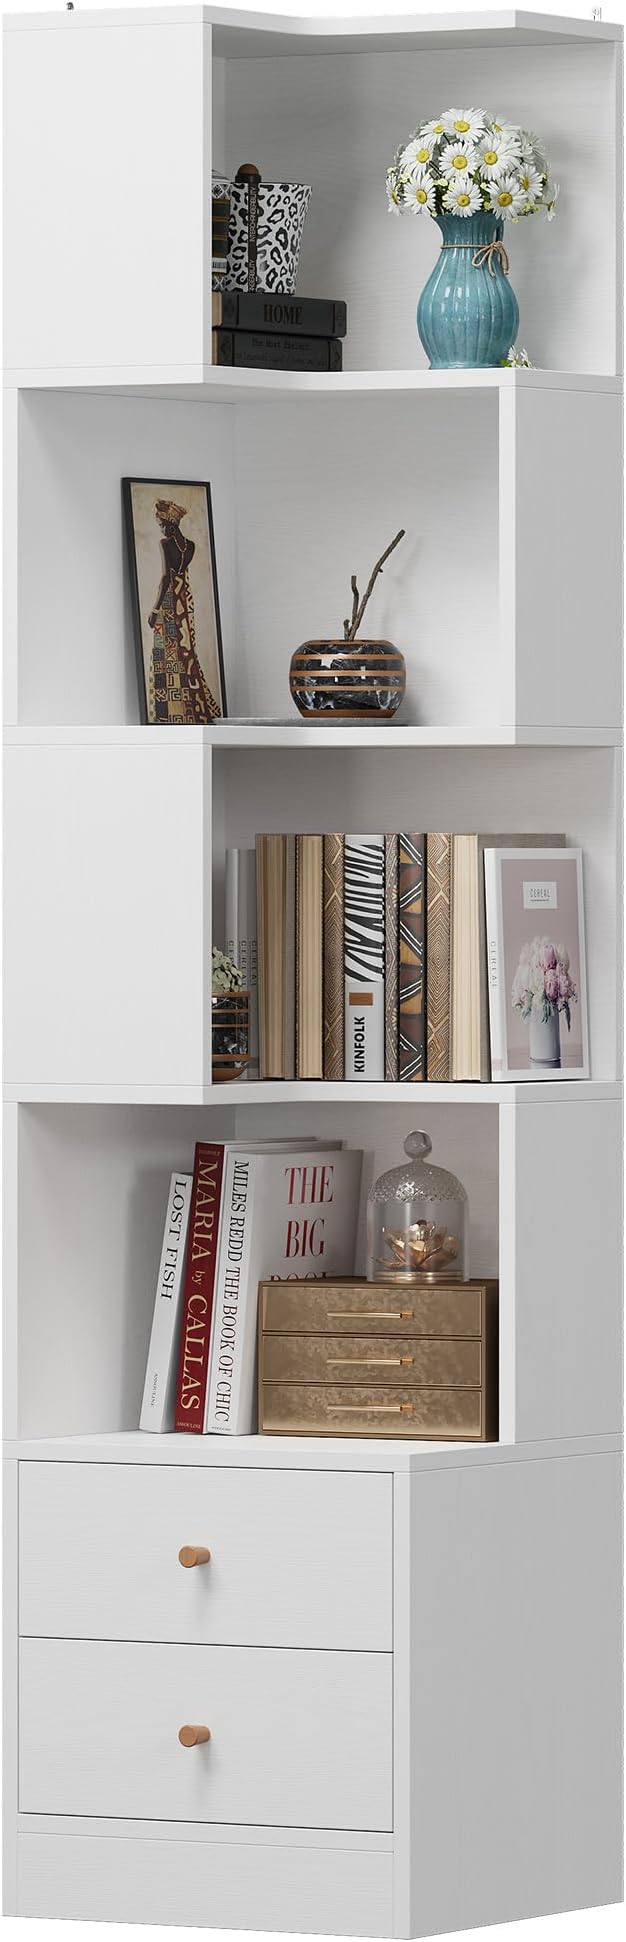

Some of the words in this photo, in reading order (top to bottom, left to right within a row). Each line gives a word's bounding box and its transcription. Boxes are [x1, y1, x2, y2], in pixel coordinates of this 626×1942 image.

[263, 304, 304, 325] HOME
[529, 888, 551, 898] CEREAL
[353, 1016, 365, 1073] KINFOLK
[232, 1160, 250, 1213] MILES
[284, 1165, 334, 1205] THE
[169, 1181, 187, 1242] LOST
[191, 1160, 218, 1262] MARIA
[227, 1215, 246, 1262] REDD
[284, 1219, 326, 1258] BIG
[161, 1248, 179, 1300] FISH
[191, 1270, 206, 1285] by
[223, 1267, 240, 1301] THE
[220, 1303, 237, 1351] BOOK
[180, 1294, 208, 1410] CALLAS
[216, 1354, 234, 1377] OF
[213, 1382, 232, 1422] CHIC
